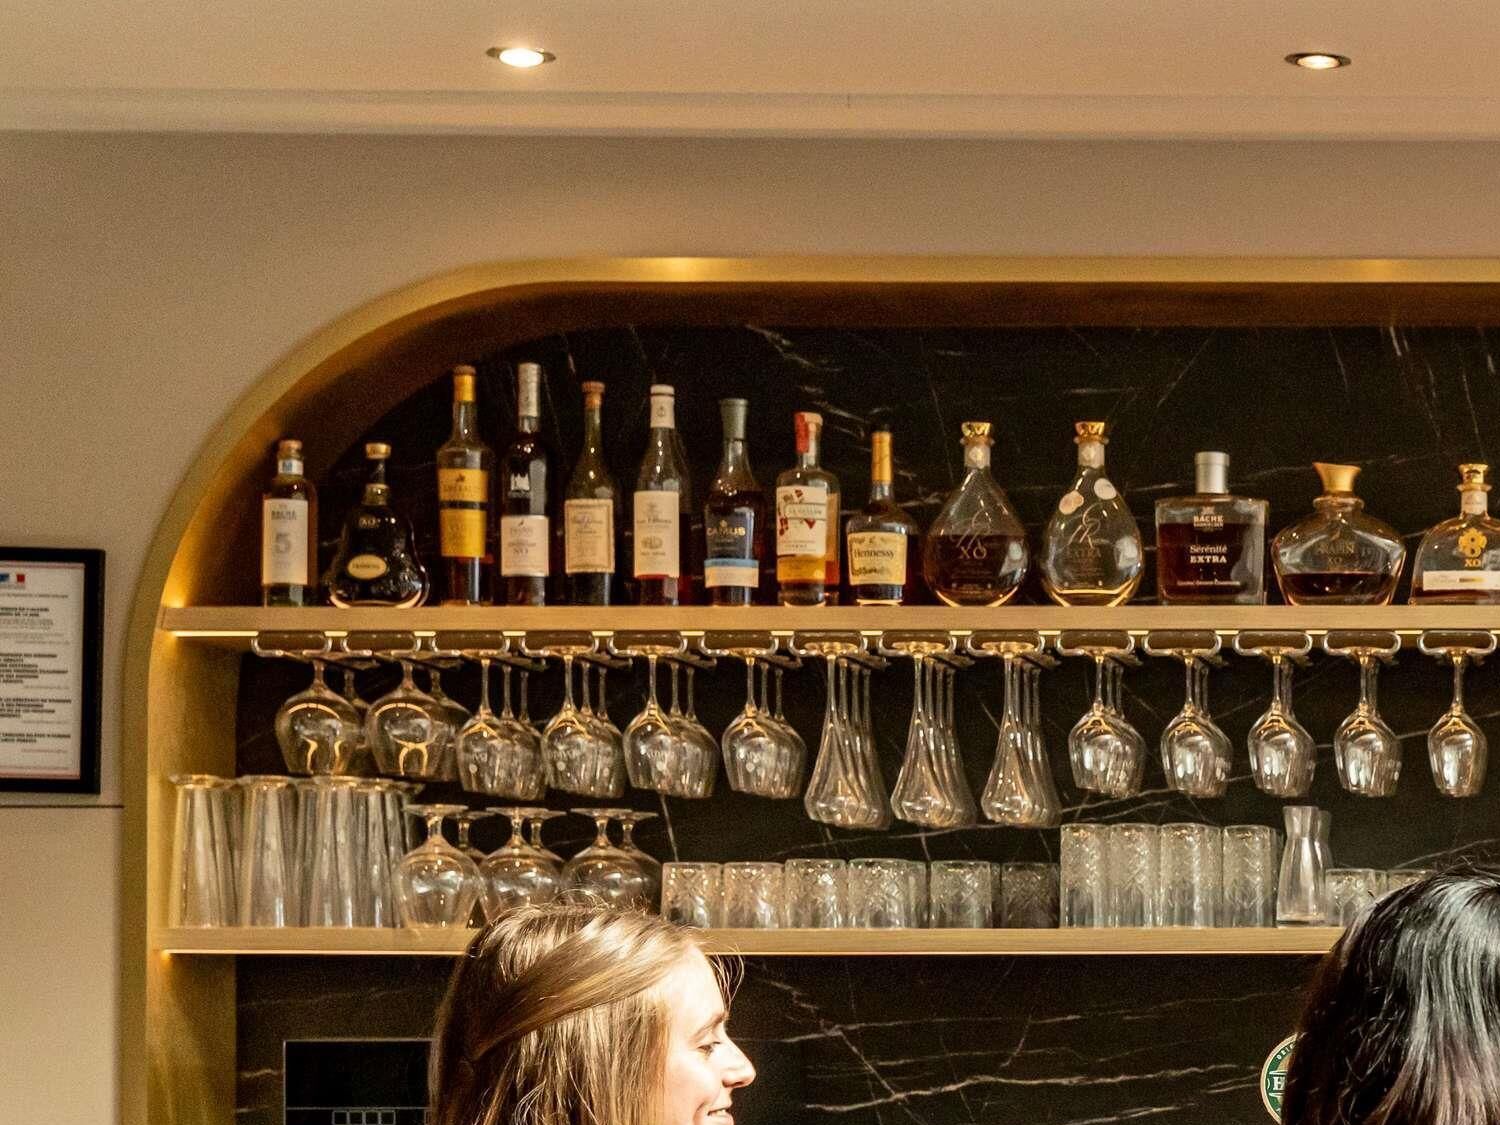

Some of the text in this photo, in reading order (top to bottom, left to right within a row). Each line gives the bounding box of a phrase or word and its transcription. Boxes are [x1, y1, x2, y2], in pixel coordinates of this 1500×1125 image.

[707, 526, 746, 537] CAMUS
[853, 550, 896, 560] Hennessy
[962, 546, 987, 560] XO
[1190, 555, 1228, 564] EXTRA
[1464, 558, 1480, 568] XO
